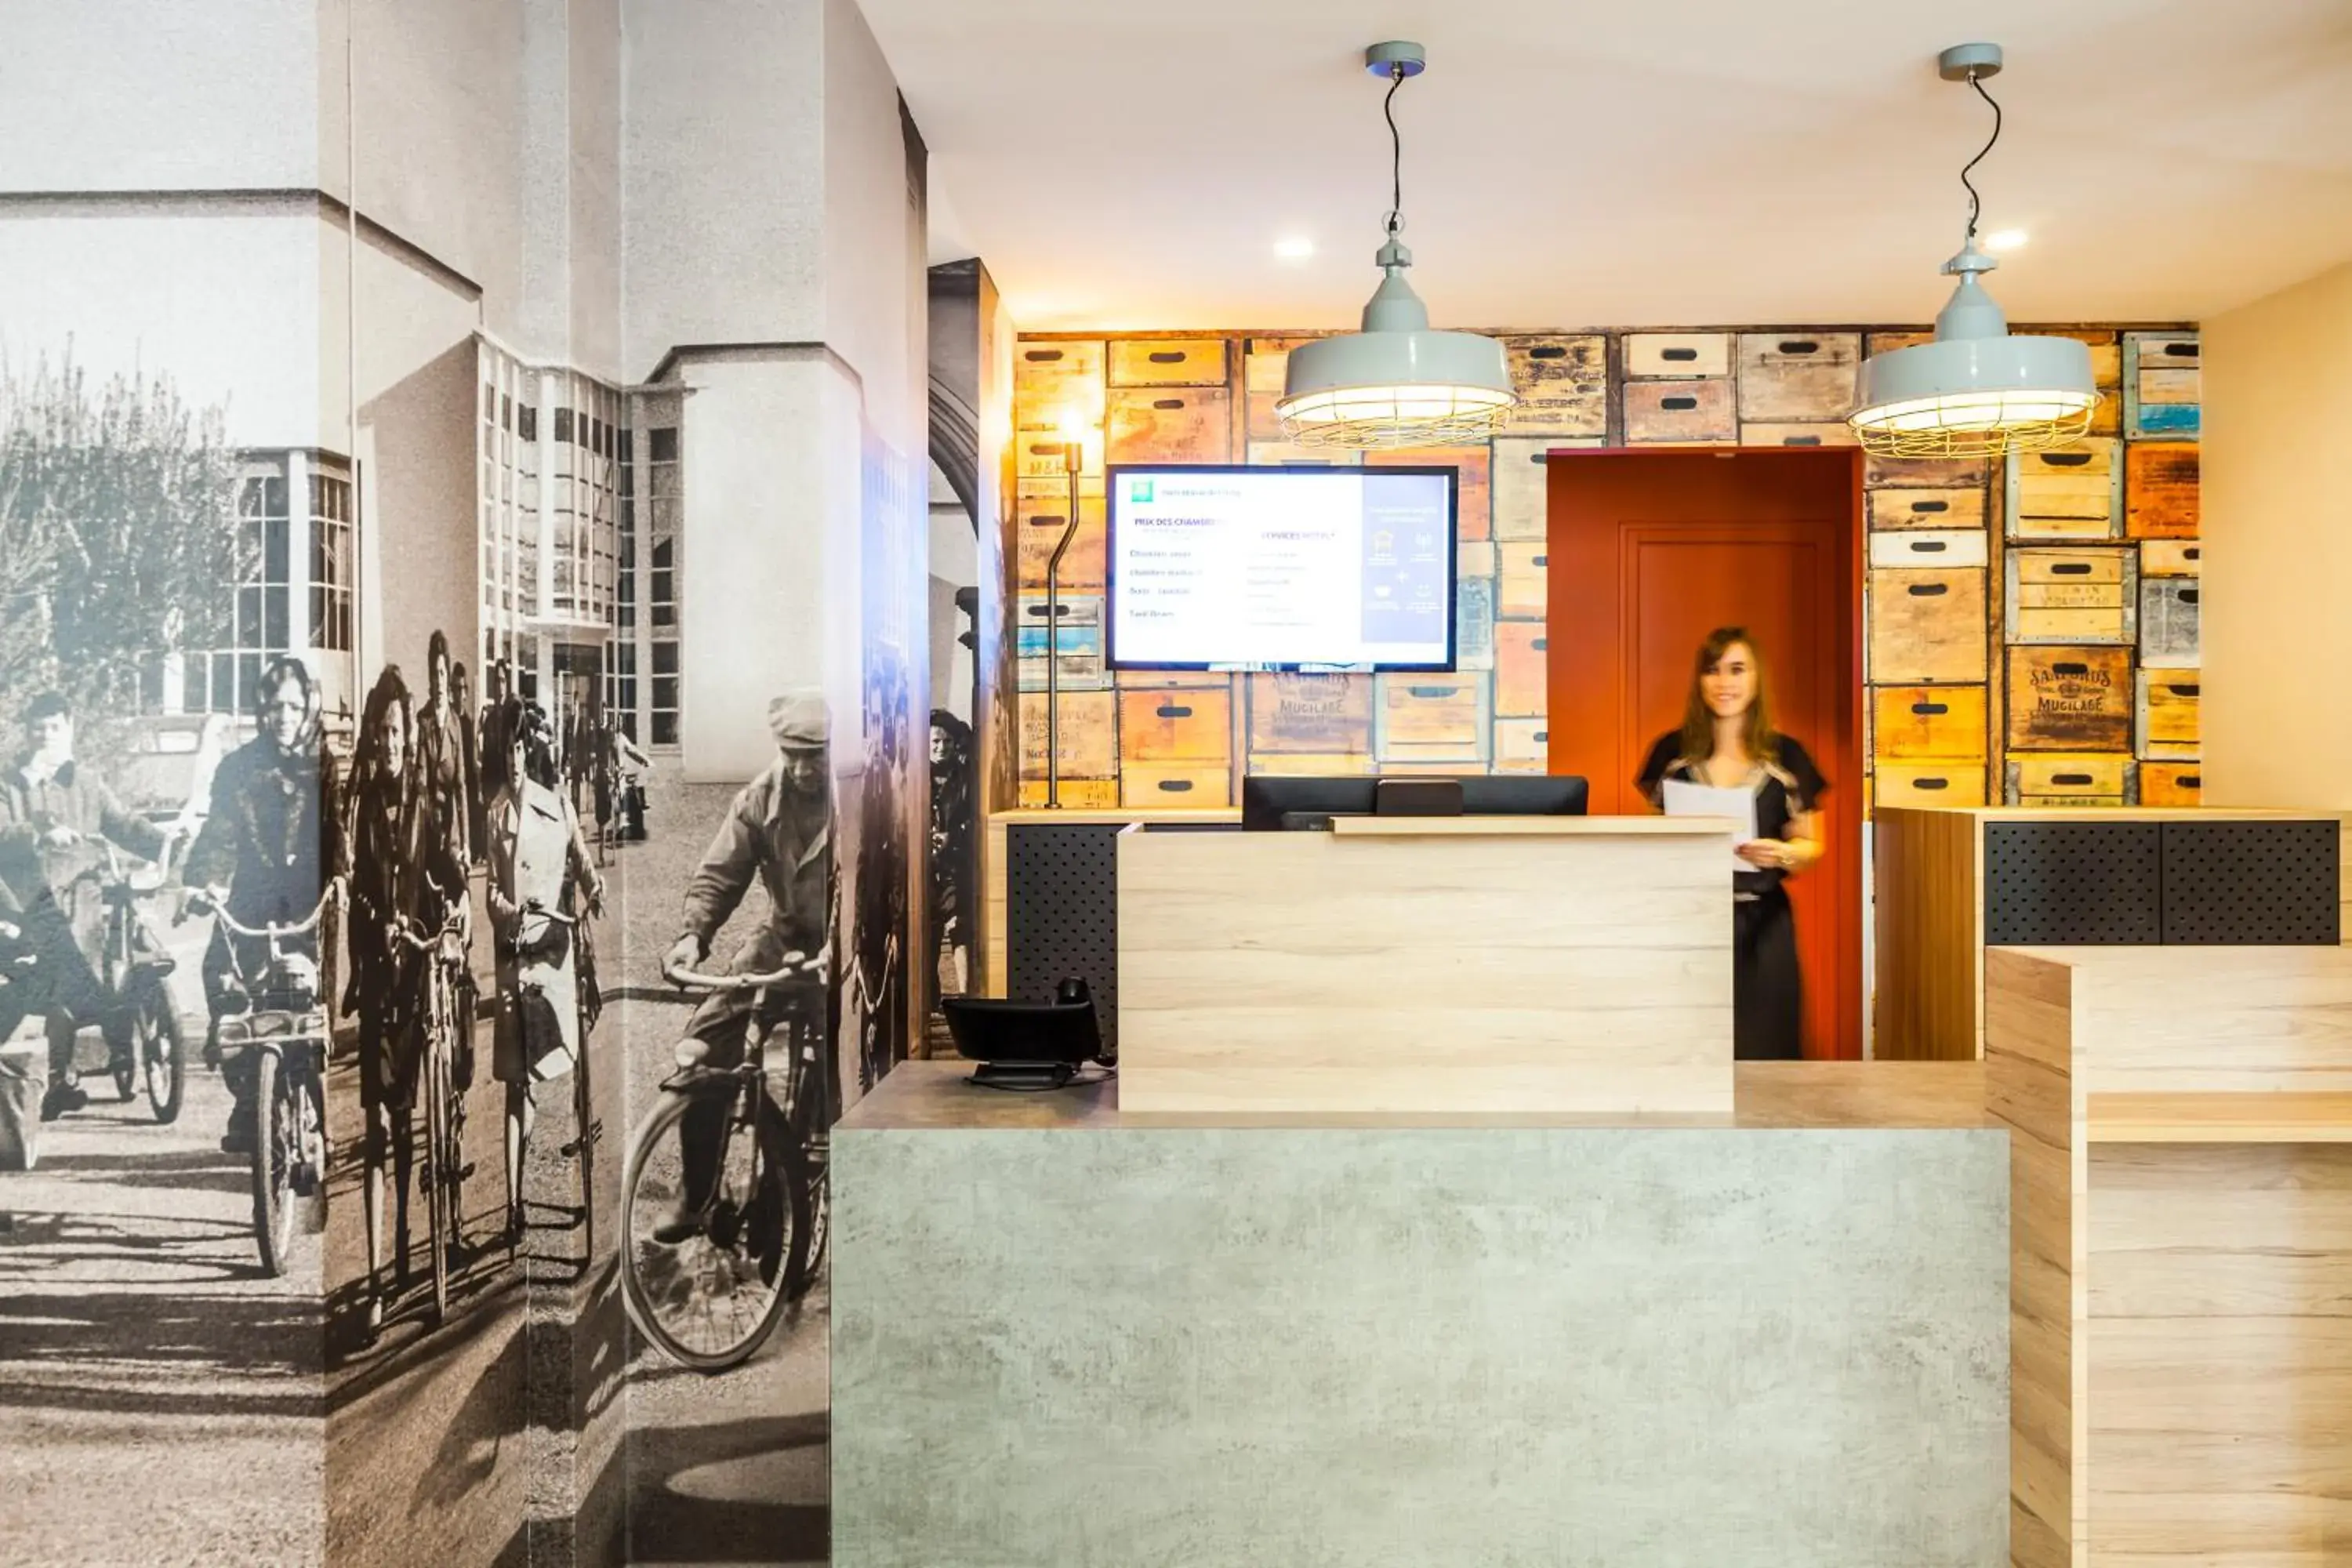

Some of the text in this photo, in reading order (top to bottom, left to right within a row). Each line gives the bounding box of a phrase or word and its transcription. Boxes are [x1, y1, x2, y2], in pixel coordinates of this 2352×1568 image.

[1134, 517, 1229, 527] PRIX DES CHAMBR
[2038, 695, 2104, 712] MUCILAGE
